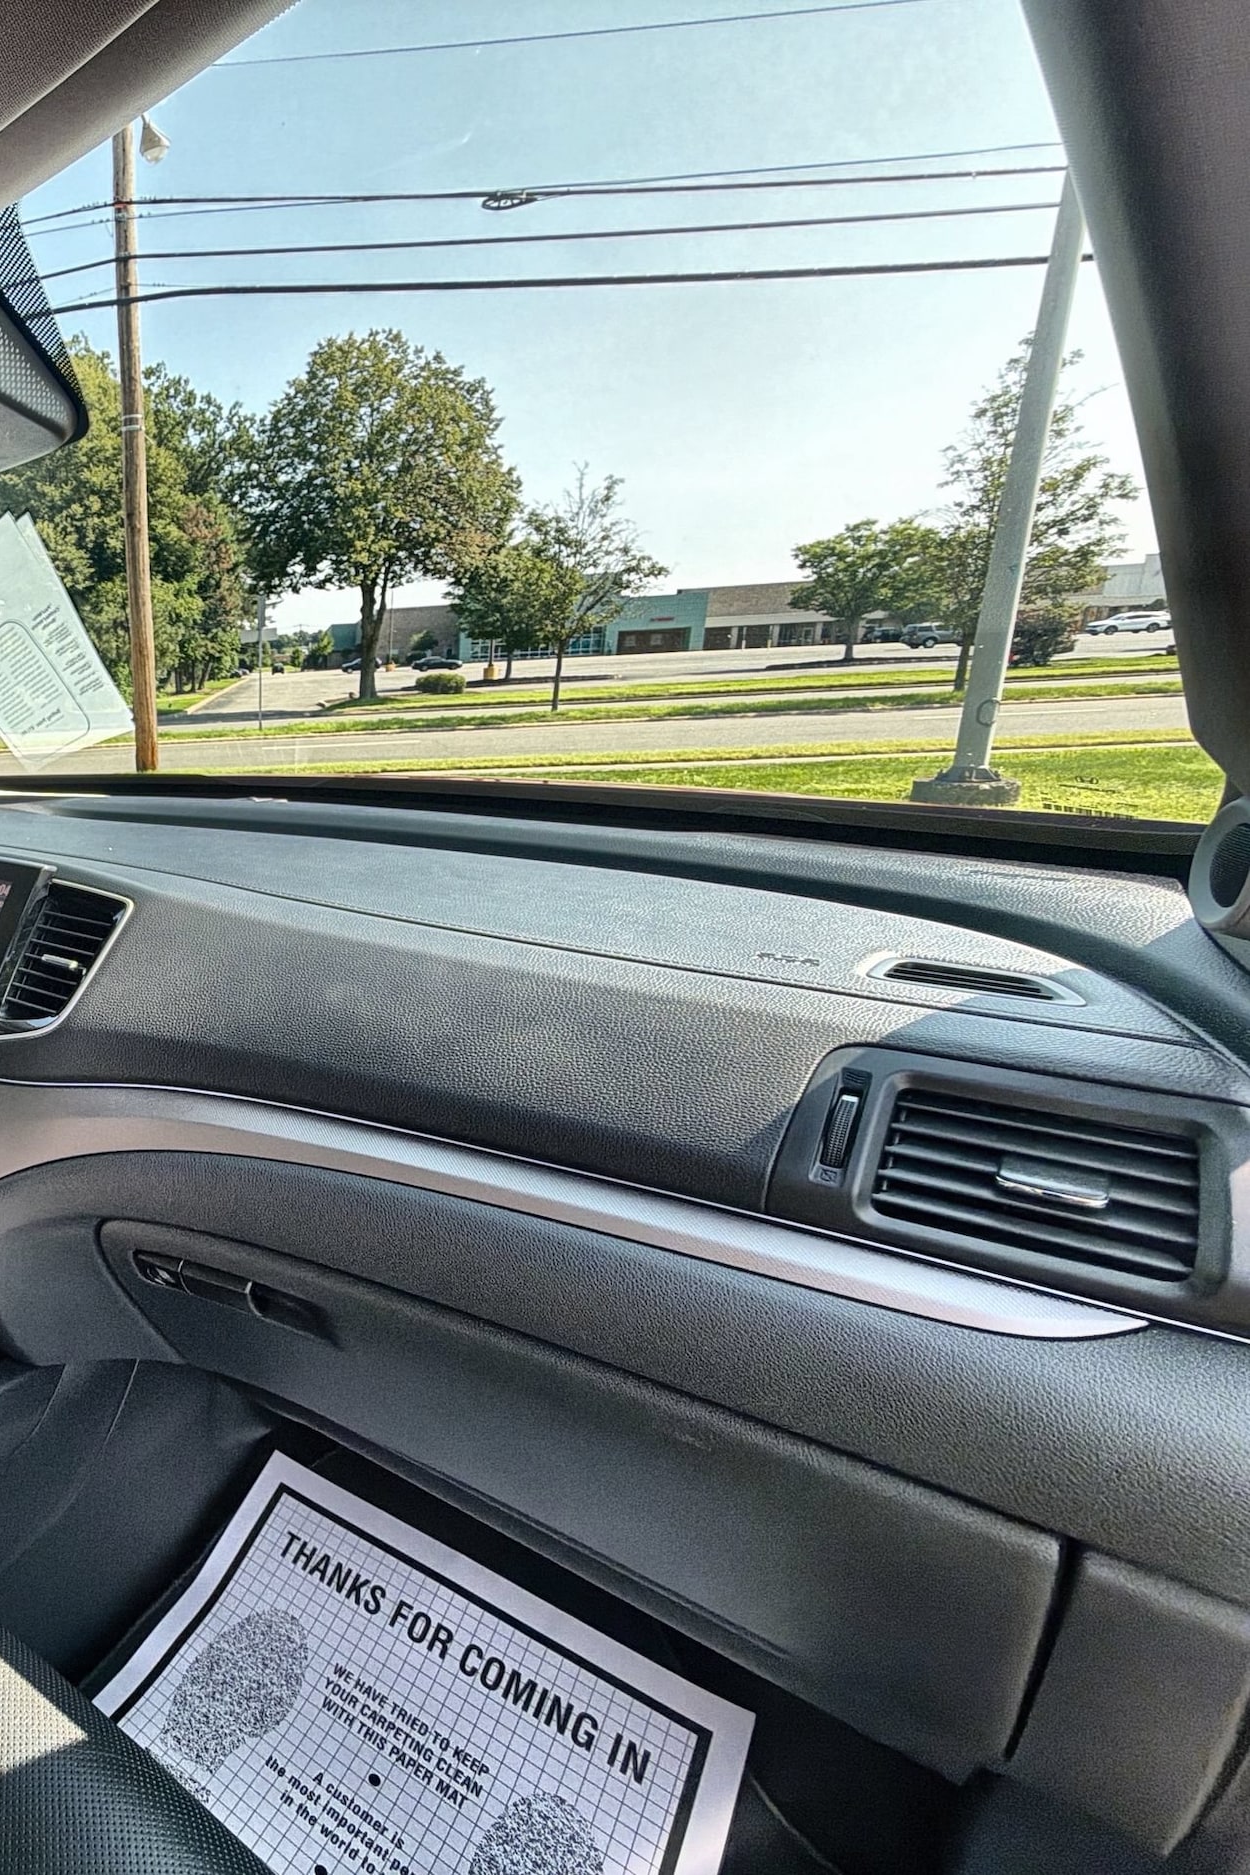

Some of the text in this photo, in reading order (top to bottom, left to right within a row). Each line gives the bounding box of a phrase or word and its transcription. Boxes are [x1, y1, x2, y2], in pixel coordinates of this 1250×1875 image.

[280, 1530, 652, 1786] THANKS FOR COMING IN
[321, 1695, 468, 1810] WITH THIS PAPER MAT
[324, 1677, 483, 1798] YOUR CARPETING CLEAN
[333, 1663, 490, 1777] WE HAVE TRIED TO KEEP
[265, 1755, 287, 1777] the
[288, 1775, 321, 1806] most
[322, 1800, 391, 1862] important
[280, 1790, 376, 1874] in the world to
[312, 1772, 405, 1850] A customer is
